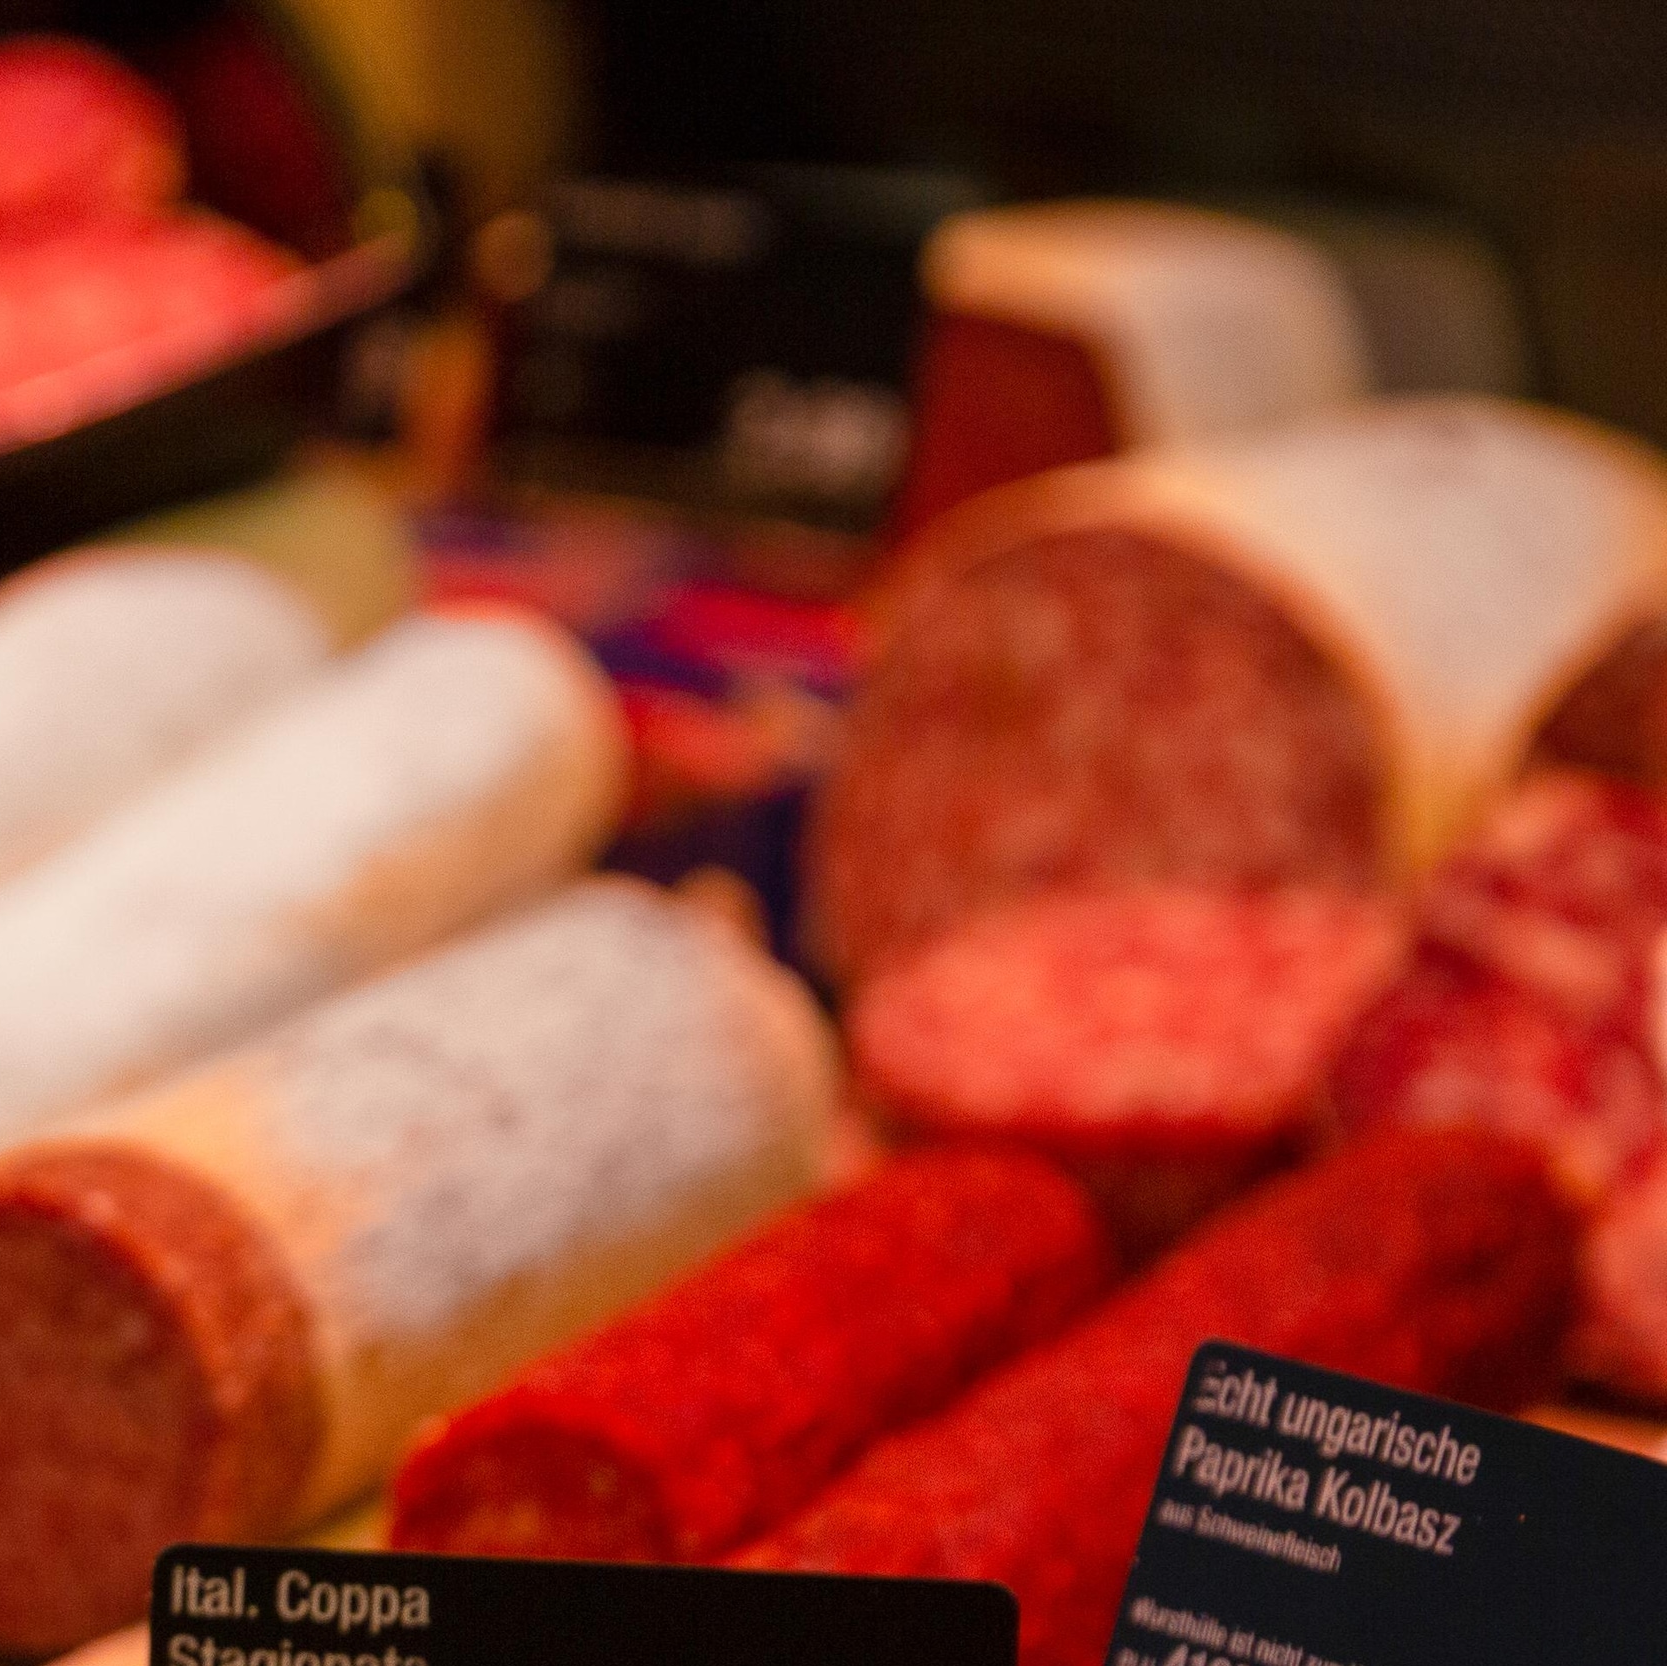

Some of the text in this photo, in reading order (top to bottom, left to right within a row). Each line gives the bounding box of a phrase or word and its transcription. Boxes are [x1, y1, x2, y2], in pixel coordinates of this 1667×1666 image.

[1278, 1390, 1482, 1487] ungarische
[1172, 1422, 1463, 1558] Paprika Kolbasz
[1157, 1496, 1343, 1575] aus Schweinefleisch
[169, 1564, 432, 1636] Ital. Coppa
[1130, 1595, 1228, 1650] Wursthülle
[1227, 1627, 1256, 1658] ist
